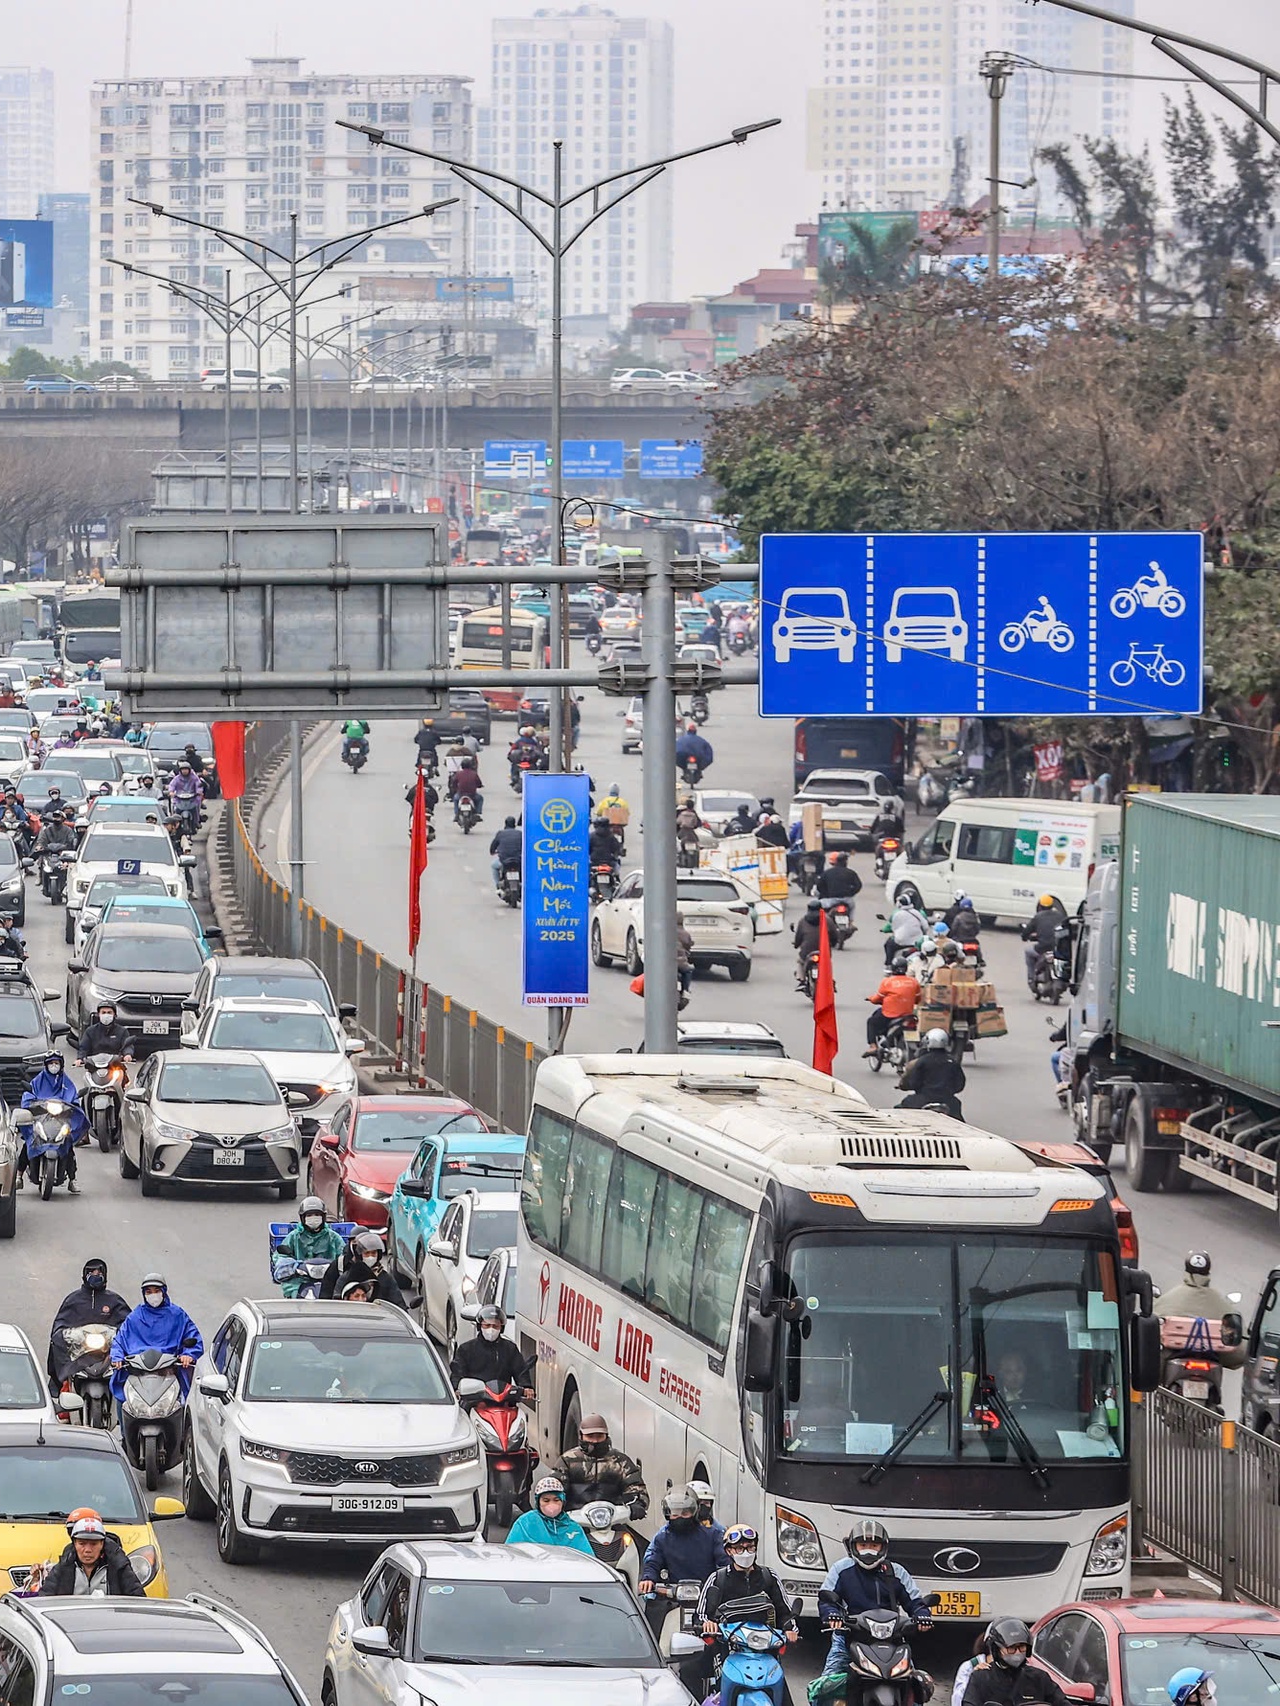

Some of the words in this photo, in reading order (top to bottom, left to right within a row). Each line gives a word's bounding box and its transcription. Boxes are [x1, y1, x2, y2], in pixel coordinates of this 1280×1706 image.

[534, 838, 582, 854] Chúc
[540, 930, 575, 942] 2025
[527, 995, 547, 1005] QUẬN
[549, 994, 573, 1004] HOÀNG
[557, 1283, 603, 1352] HOANG
[615, 1317, 654, 1383] LONG
[659, 1367, 702, 1416] EXPRESS
[338, 1499, 398, 1510] 30G-912.09
[947, 1593, 967, 1603] 15B
